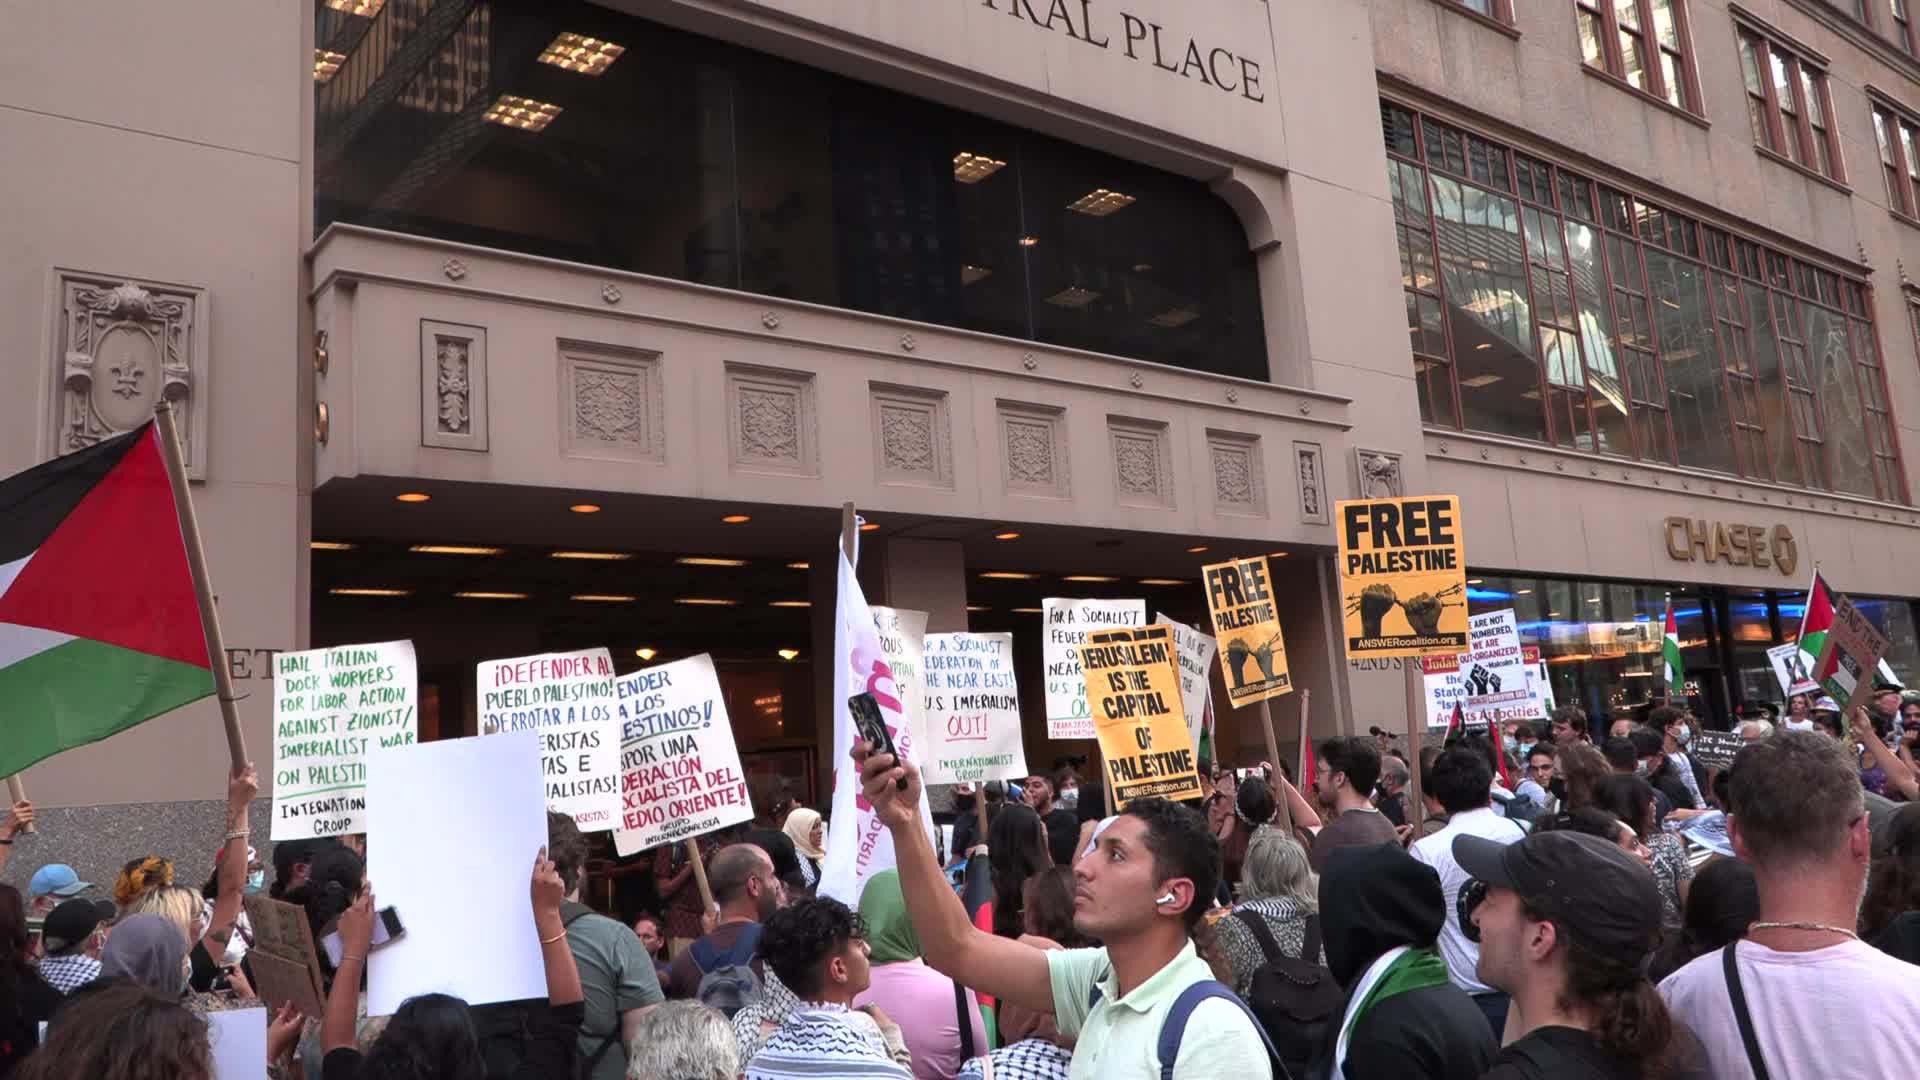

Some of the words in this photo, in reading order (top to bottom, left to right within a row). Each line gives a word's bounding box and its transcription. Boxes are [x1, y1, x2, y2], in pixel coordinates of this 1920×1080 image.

[1119, 11, 1265, 103] PLACE
[1344, 500, 1455, 550] FREE
[1664, 516, 1771, 568] CHASE
[1347, 548, 1457, 575] PALESTINE
[1207, 561, 1269, 610] FREE
[1049, 607, 1065, 624] FOR
[1068, 609, 1076, 624] A
[1082, 606, 1140, 625] SOCIALIST
[1215, 602, 1274, 632] PALESTINE
[1474, 618, 1488, 628] ARE
[1489, 615, 1504, 624] NOT
[940, 639, 947, 652] A
[1358, 636, 1458, 650] ANSWERcoalition.org
[1472, 641, 1483, 650] WE
[1485, 638, 1499, 648] ARE
[280, 656, 311, 673] HAIL
[324, 650, 378, 669] ITALIAN
[597, 656, 613, 677] AL
[990, 659, 1001, 669] OF
[1081, 642, 1167, 669] JERUSALEM
[1460, 646, 1518, 664] OUT-ORGANIZED!
[285, 676, 320, 693] DOCK
[330, 665, 394, 688] WORKERS
[947, 671, 980, 689] NEAR
[984, 669, 1014, 689] EAST!
[1107, 671, 1126, 692] IS
[1125, 669, 1151, 691] THE
[1446, 675, 1463, 684] the
[280, 696, 304, 712] FOR
[312, 692, 348, 711] LABOR
[359, 688, 406, 707] ACTION
[485, 687, 540, 710] PUEBLO
[543, 679, 613, 703] PALESTINO!
[953, 693, 1018, 711] IMPERIALISM
[1434, 687, 1464, 698] State
[567, 706, 575, 724] A
[582, 705, 610, 722] LOS
[635, 694, 665, 715] LOS
[1103, 691, 1170, 720] CAPITAL
[278, 715, 339, 737] AGAINST
[620, 700, 713, 741] ESTINOS!
[947, 712, 988, 736] OUT!
[280, 738, 368, 759] IMPERIALIST
[380, 732, 414, 748] WAR
[661, 734, 698, 758] UNA
[1135, 727, 1152, 750] OF
[277, 769, 300, 786] ON
[308, 763, 367, 784] PALESTI
[579, 754, 591, 772] E
[955, 768, 984, 781] GROUP
[1109, 748, 1194, 782] PALESTINE
[705, 768, 739, 788] DEL
[669, 783, 746, 818] ORIENTE!
[314, 818, 352, 835] GROUP
